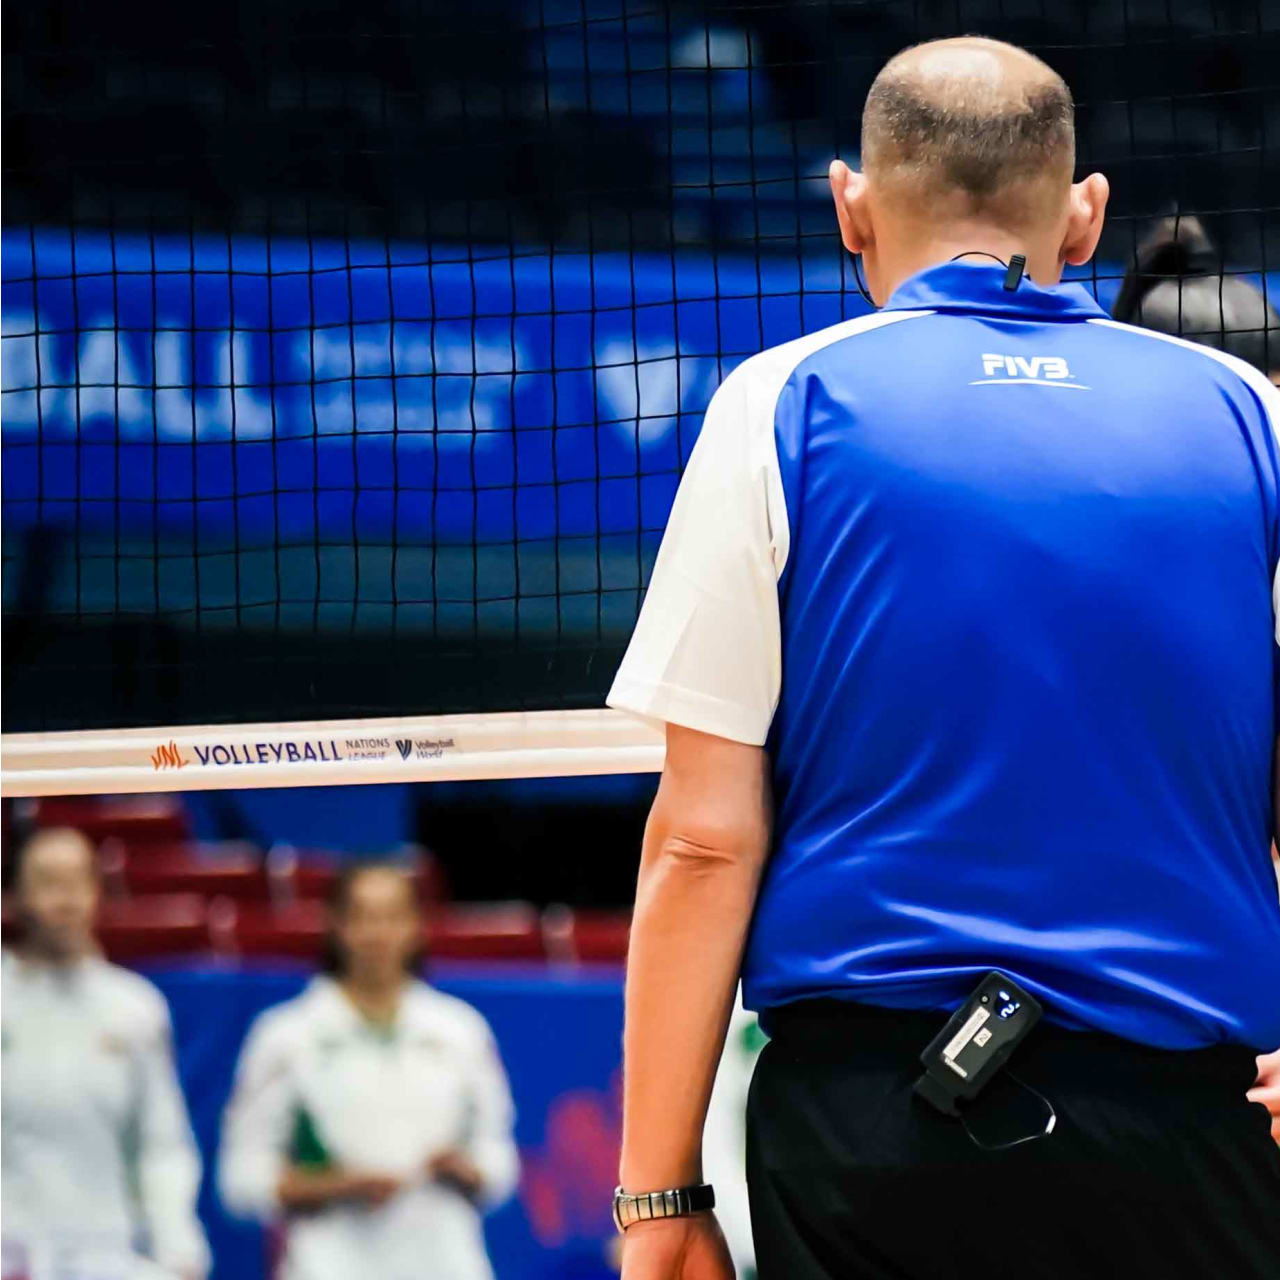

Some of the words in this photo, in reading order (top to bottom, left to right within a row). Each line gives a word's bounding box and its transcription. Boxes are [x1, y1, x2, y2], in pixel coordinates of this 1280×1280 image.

[981, 353, 1069, 379] FIVB
[193, 740, 343, 767] VOLLEYBALL
[345, 738, 390, 750] NATIONS
